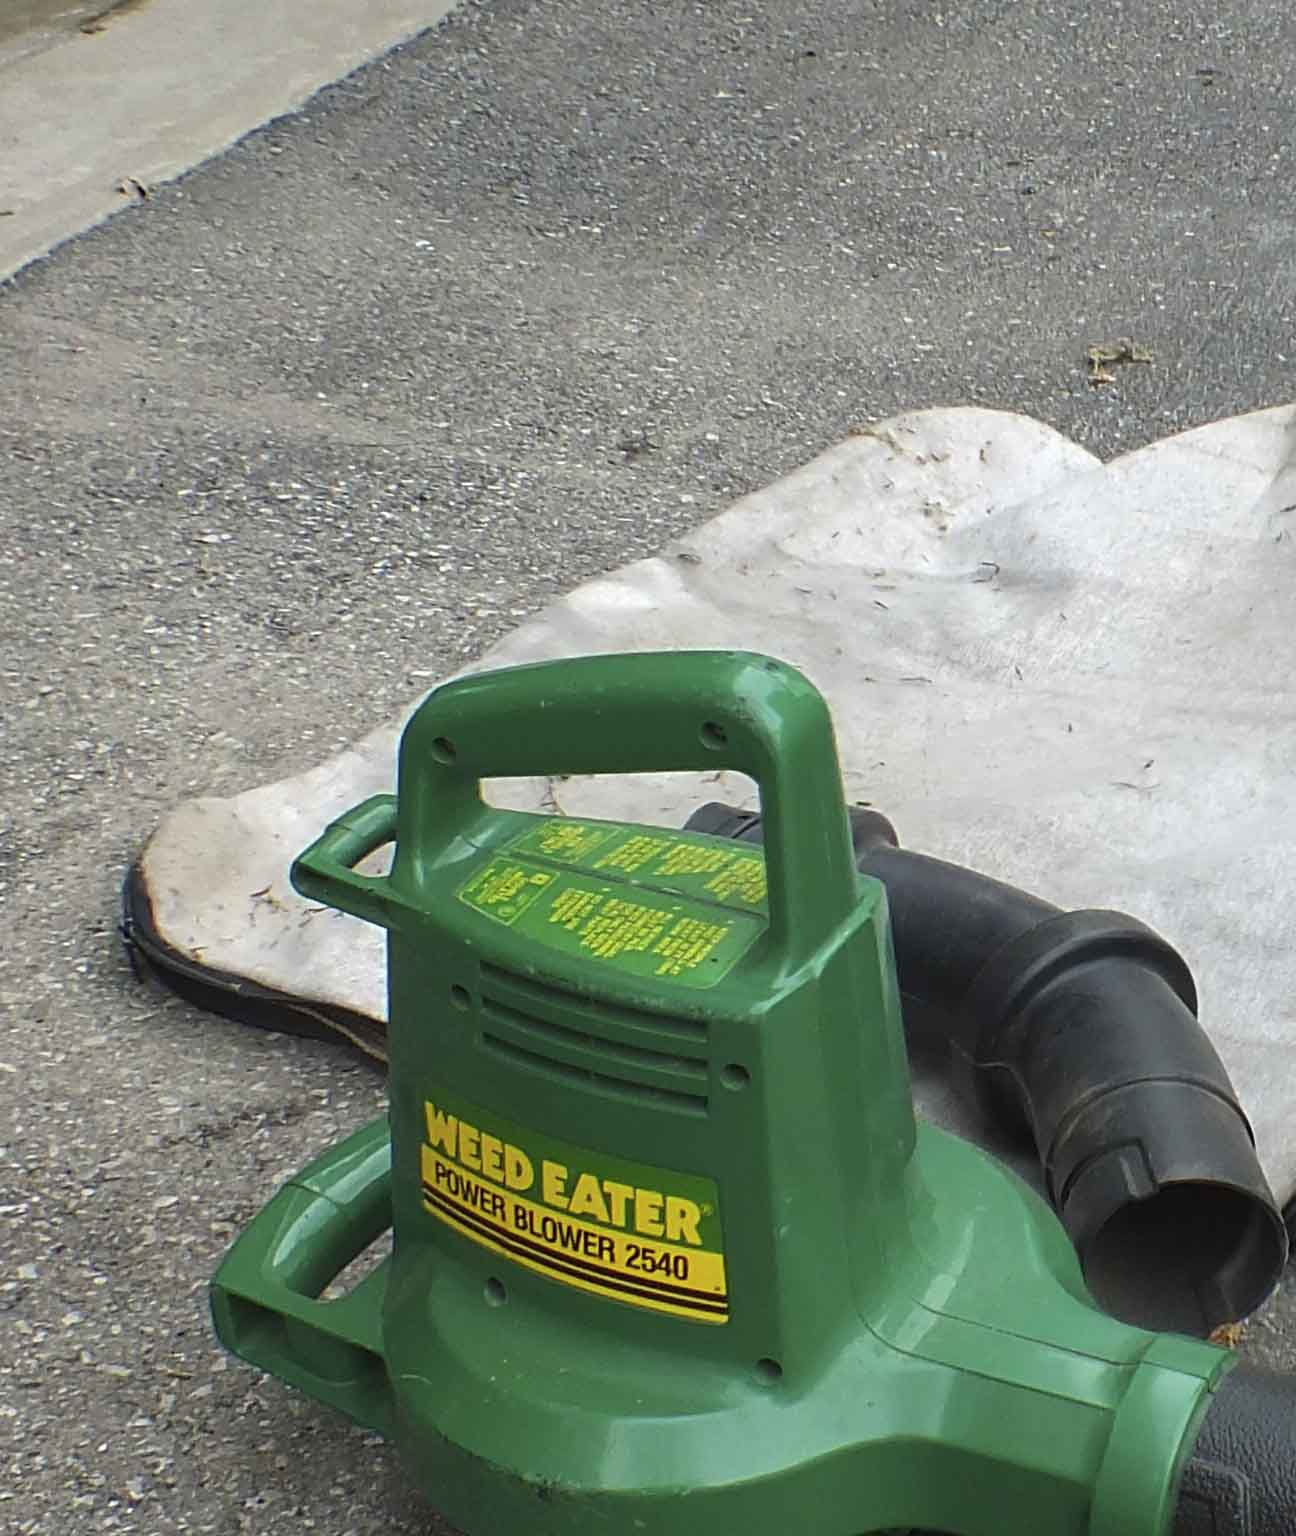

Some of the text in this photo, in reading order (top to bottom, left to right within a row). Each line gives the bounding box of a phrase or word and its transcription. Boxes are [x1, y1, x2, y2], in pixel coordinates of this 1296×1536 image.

[424, 1101, 703, 1246] WEED EATER
[434, 1162, 689, 1281] POWER BLOWER 2540
